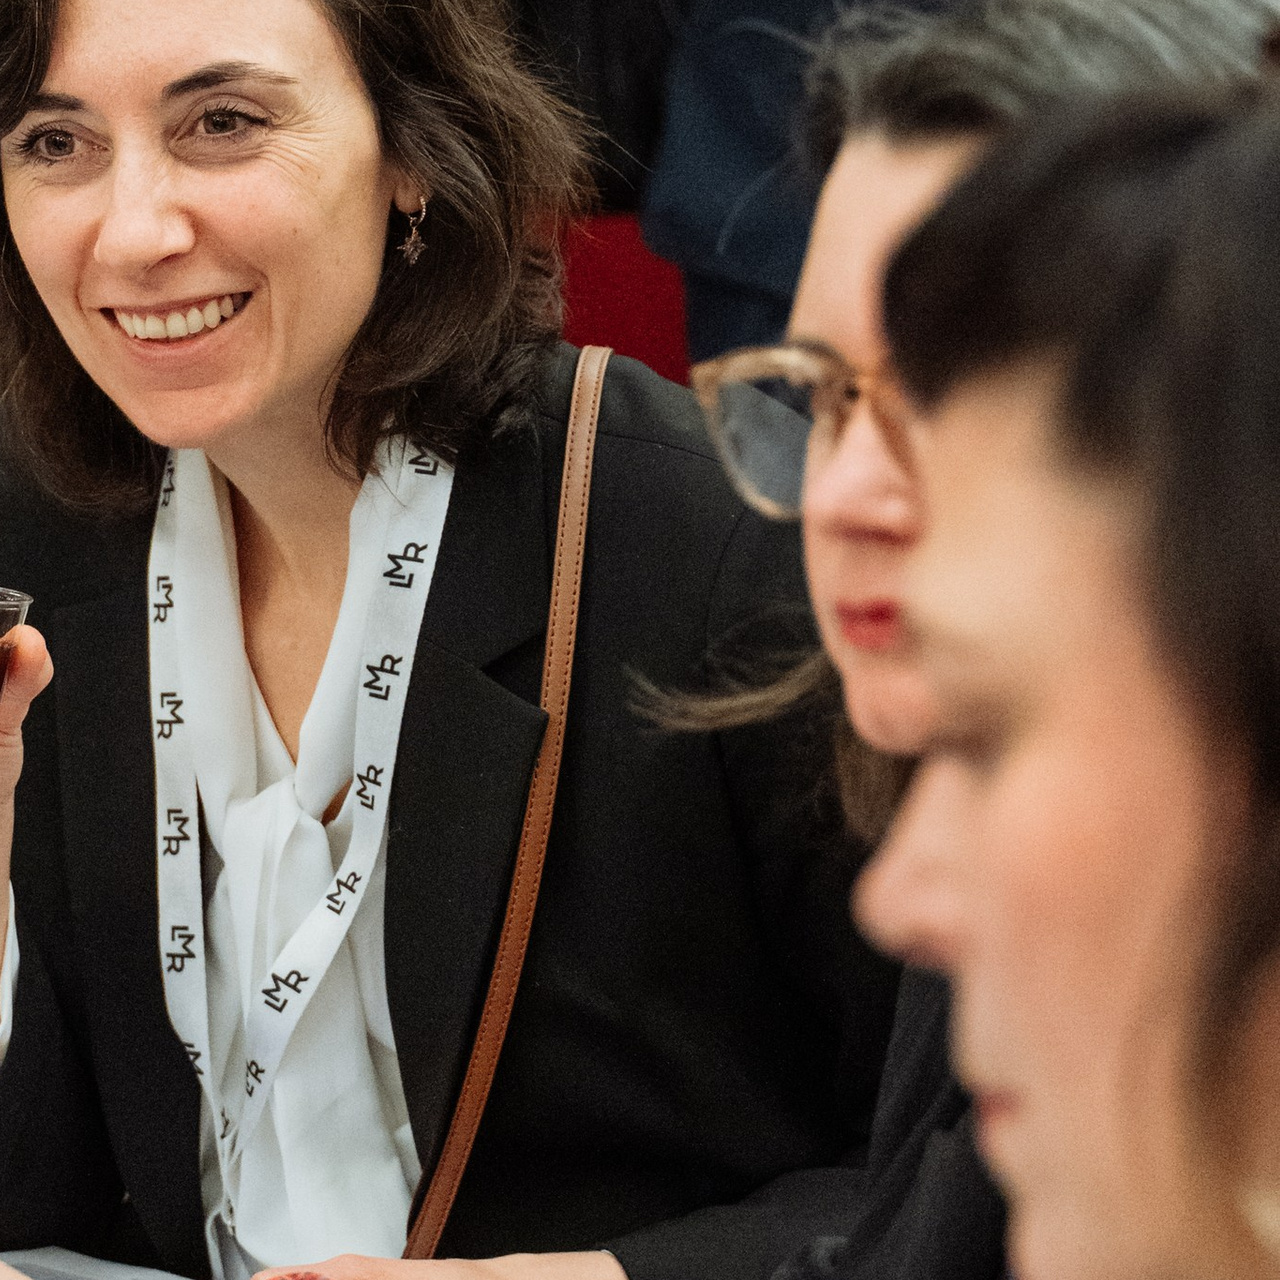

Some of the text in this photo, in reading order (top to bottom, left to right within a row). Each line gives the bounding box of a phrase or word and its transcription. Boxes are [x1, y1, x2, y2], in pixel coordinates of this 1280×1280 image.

[382, 541, 429, 589] LMR
[153, 575, 174, 623] LMR
[363, 654, 404, 701] LMR
[156, 692, 184, 739] LMR
[356, 764, 385, 811] LMR
[163, 808, 191, 856] LMR
[326, 871, 362, 916] LMR
[165, 925, 196, 973] LMR
[261, 969, 310, 1014] LMR
